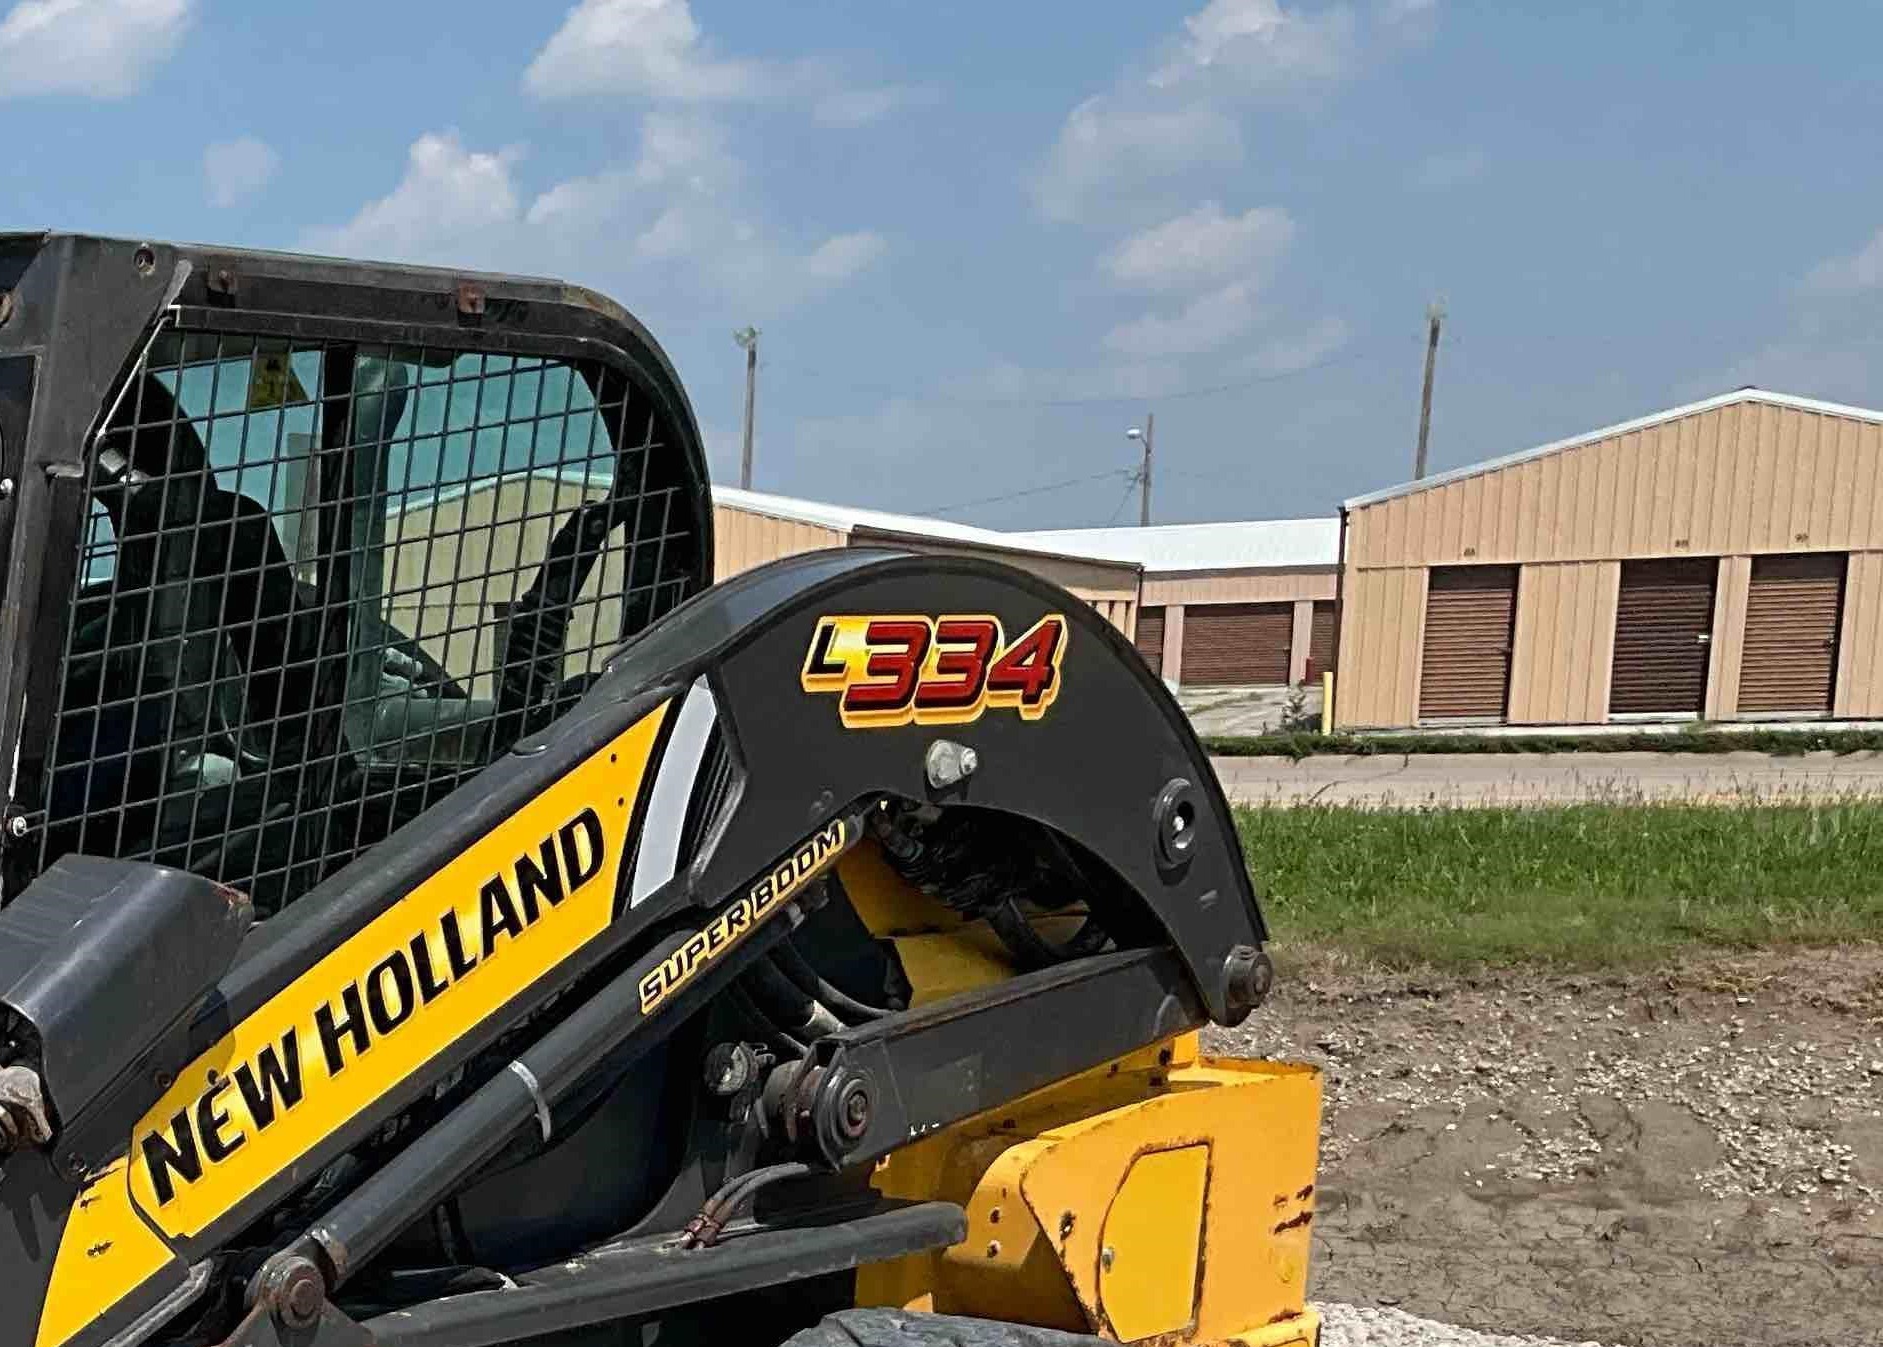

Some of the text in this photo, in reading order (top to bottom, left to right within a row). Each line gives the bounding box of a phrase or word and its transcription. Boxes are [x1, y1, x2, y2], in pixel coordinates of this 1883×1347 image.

[802, 614, 1068, 728] L334
[141, 807, 605, 1206] NEW HOLLAND
[639, 819, 845, 1014] SUPER BOOM
